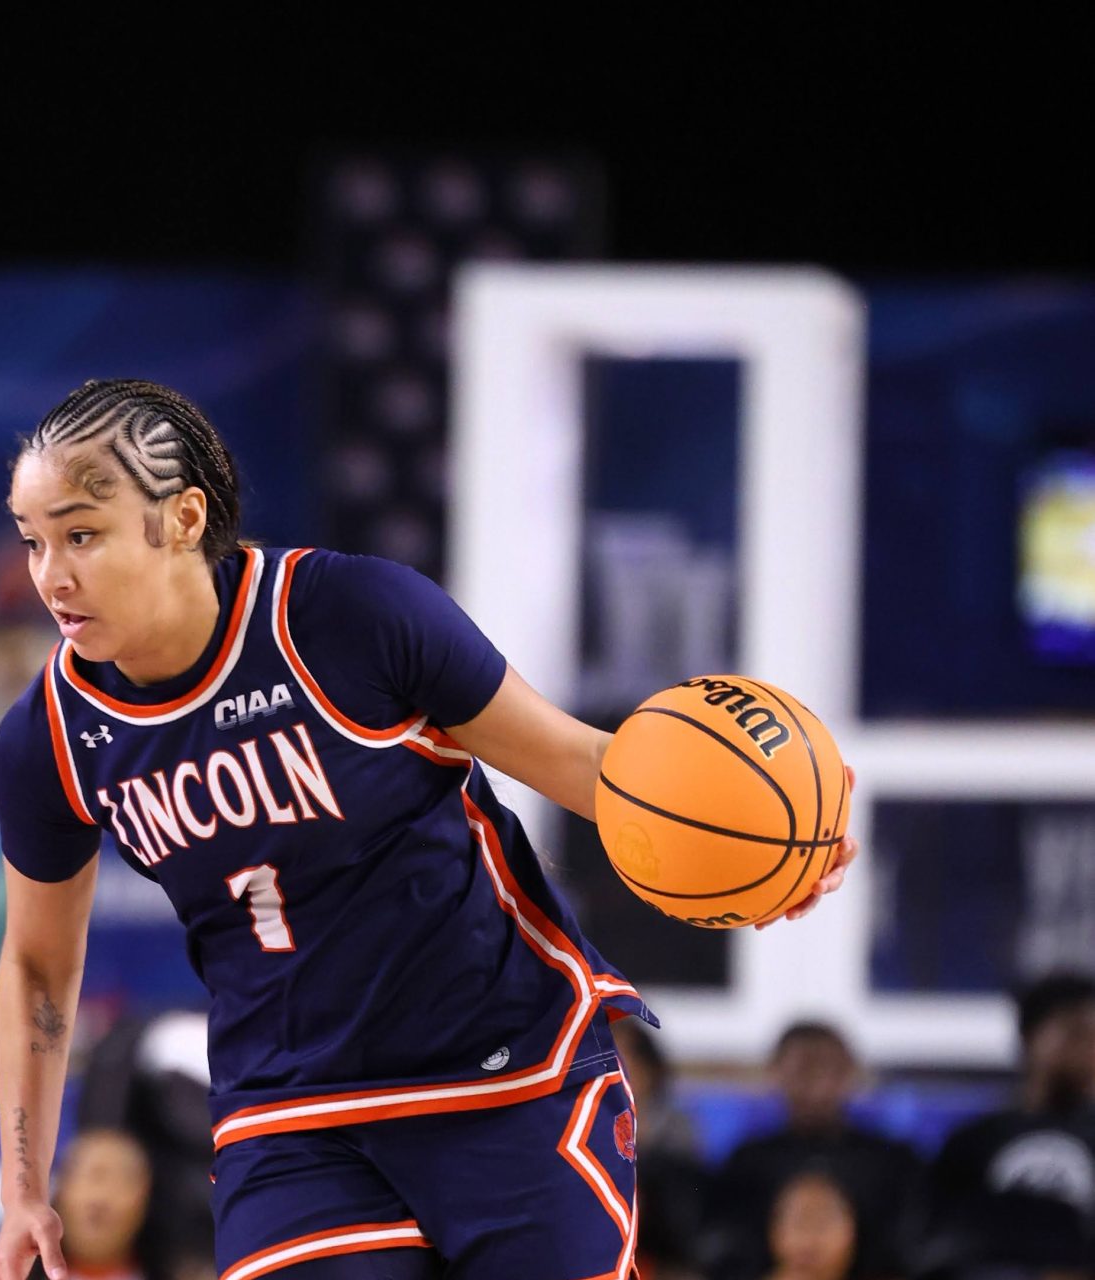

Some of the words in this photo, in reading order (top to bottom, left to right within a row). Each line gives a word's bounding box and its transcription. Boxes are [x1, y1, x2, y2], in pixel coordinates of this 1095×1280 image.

[214, 683, 295, 731] CIAA
[679, 678, 790, 760] Wilso
[97, 722, 345, 867] LINCOLN
[224, 863, 297, 951] 1
